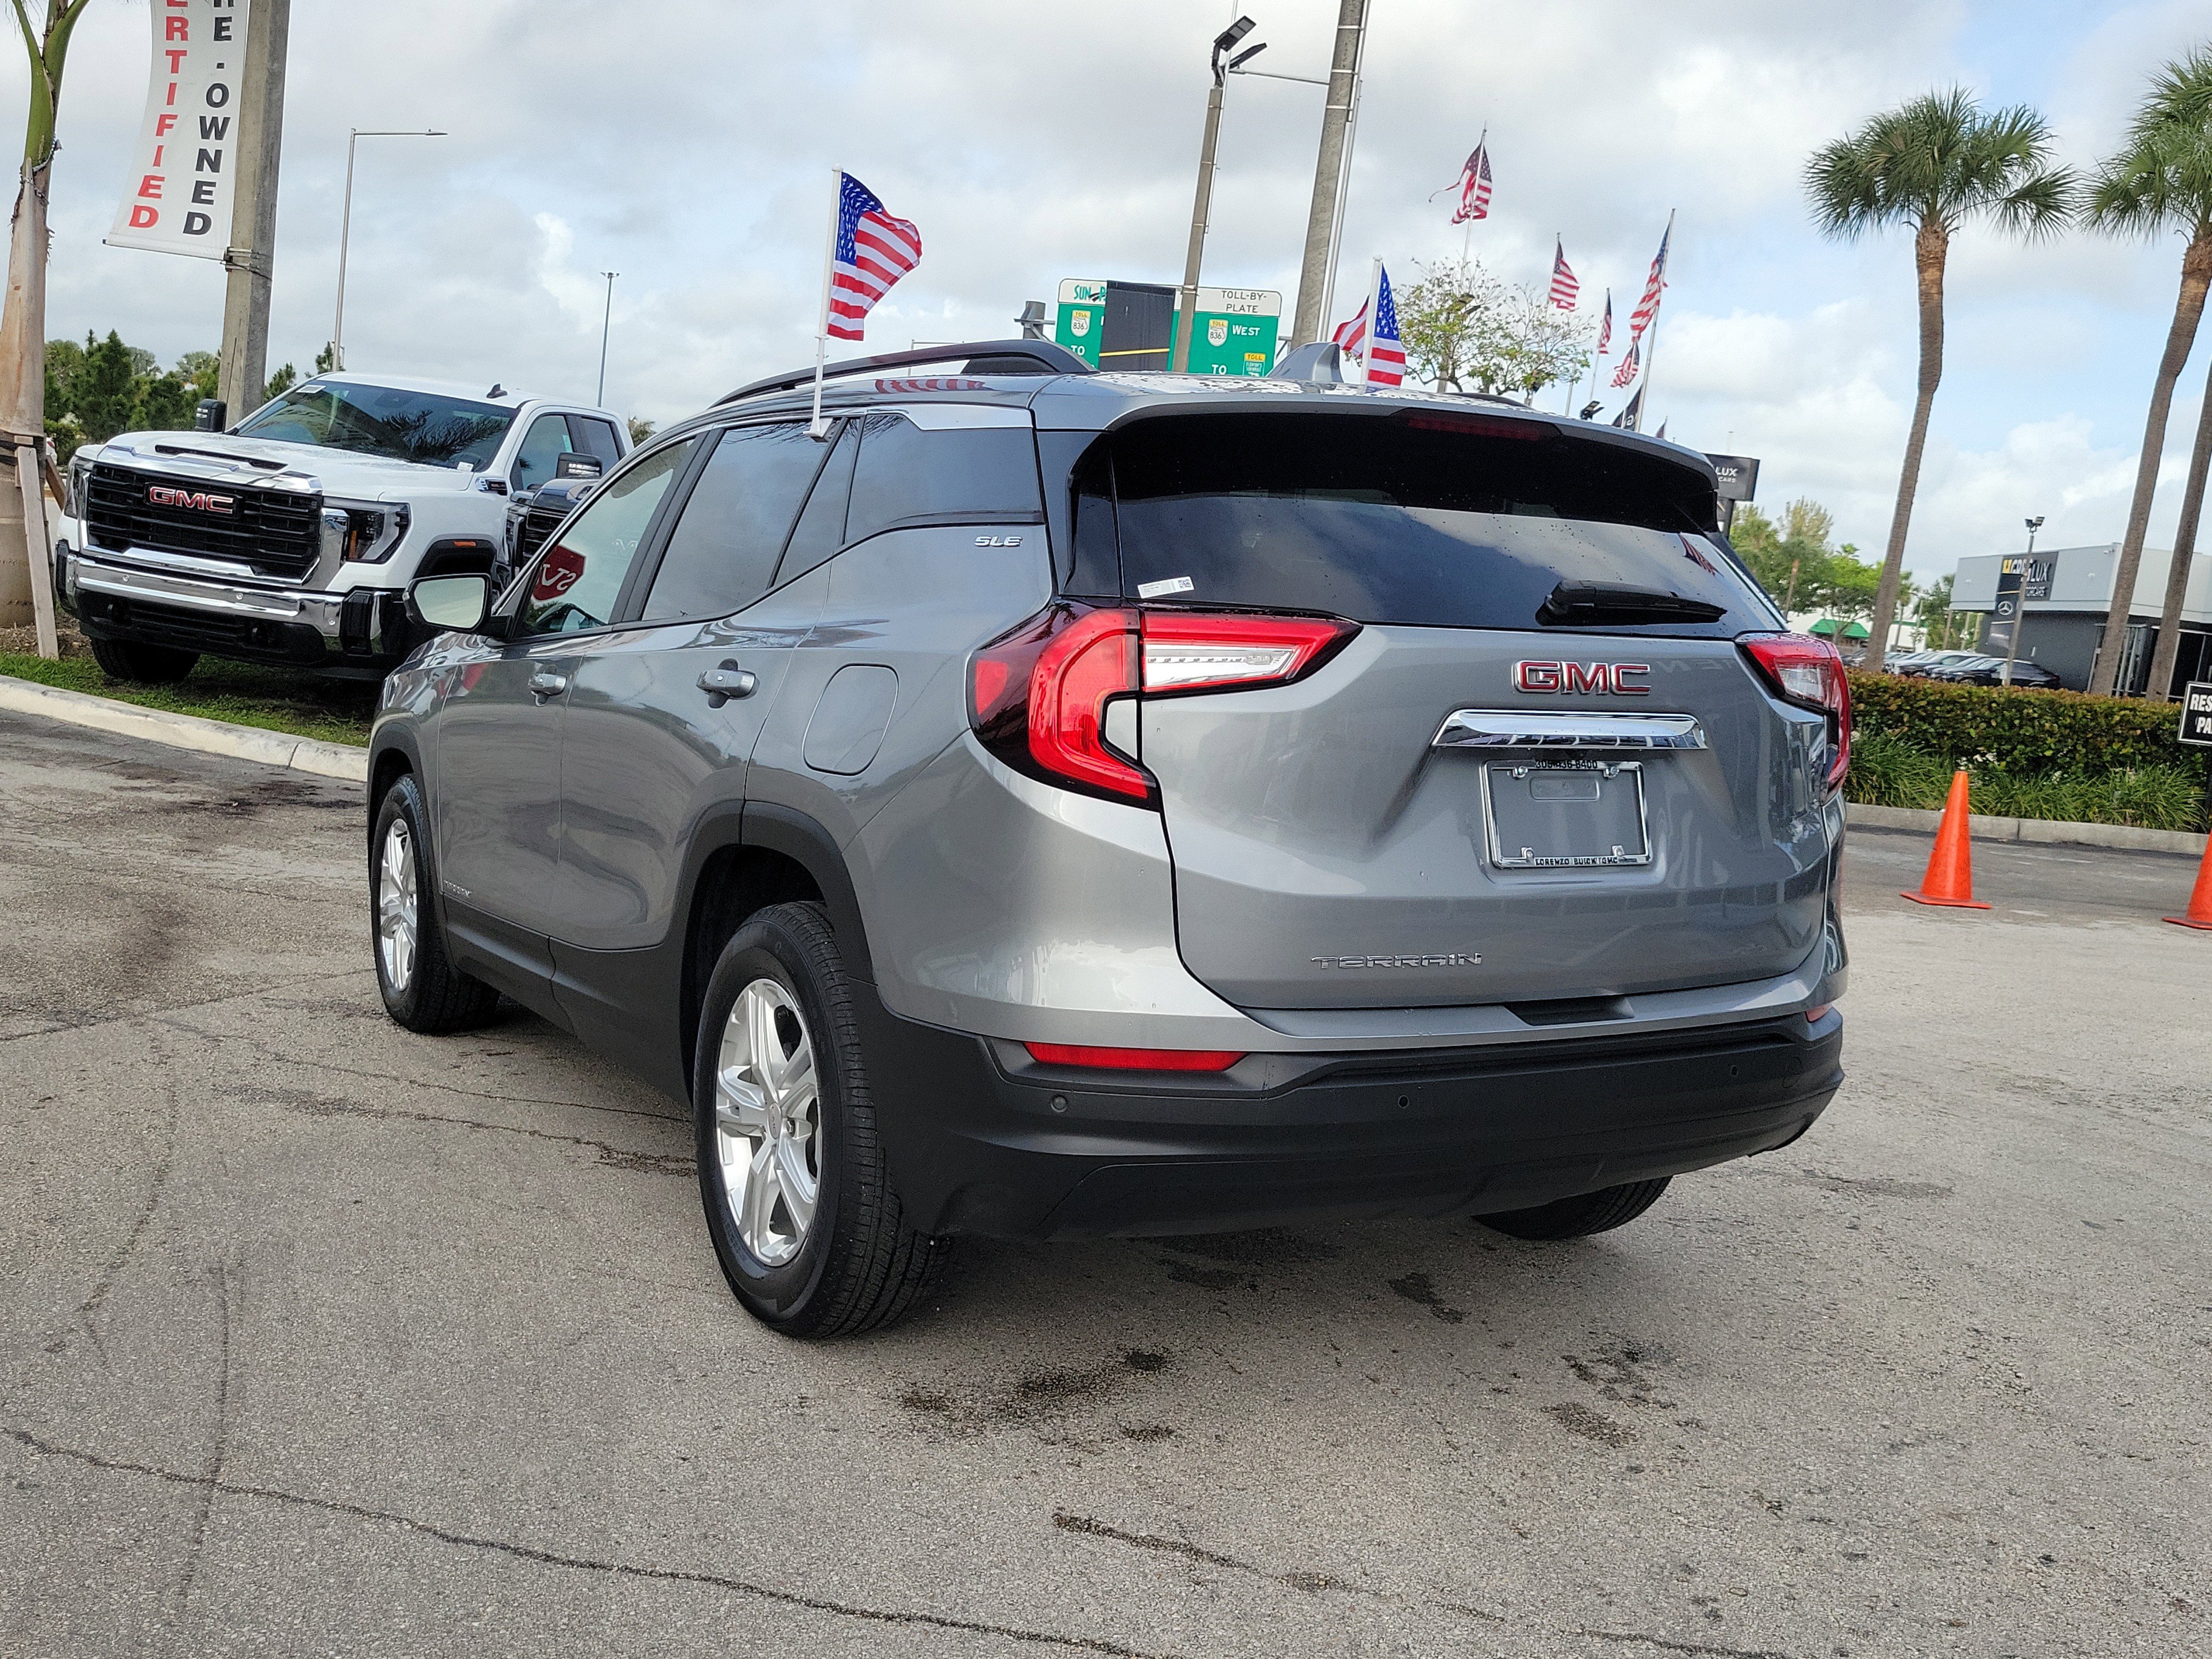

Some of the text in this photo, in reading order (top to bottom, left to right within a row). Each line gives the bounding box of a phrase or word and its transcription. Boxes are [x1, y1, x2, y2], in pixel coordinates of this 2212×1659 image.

[1222, 290, 1267, 301] TOLL-BY-
[1226, 303, 1259, 313] PLATE
[1210, 331, 1222, 340] 836
[1232, 325, 1261, 336] WEST
[1070, 345, 1085, 356] TO
[1211, 364, 1227, 375] TO
[1715, 466, 1738, 477] LUX
[150, 486, 234, 514] GMC
[974, 536, 1023, 547] SLE
[1513, 659, 1651, 695] GMC
[1573, 857, 1597, 865] BUICK
[1311, 952, 1481, 969] TERRAIN
